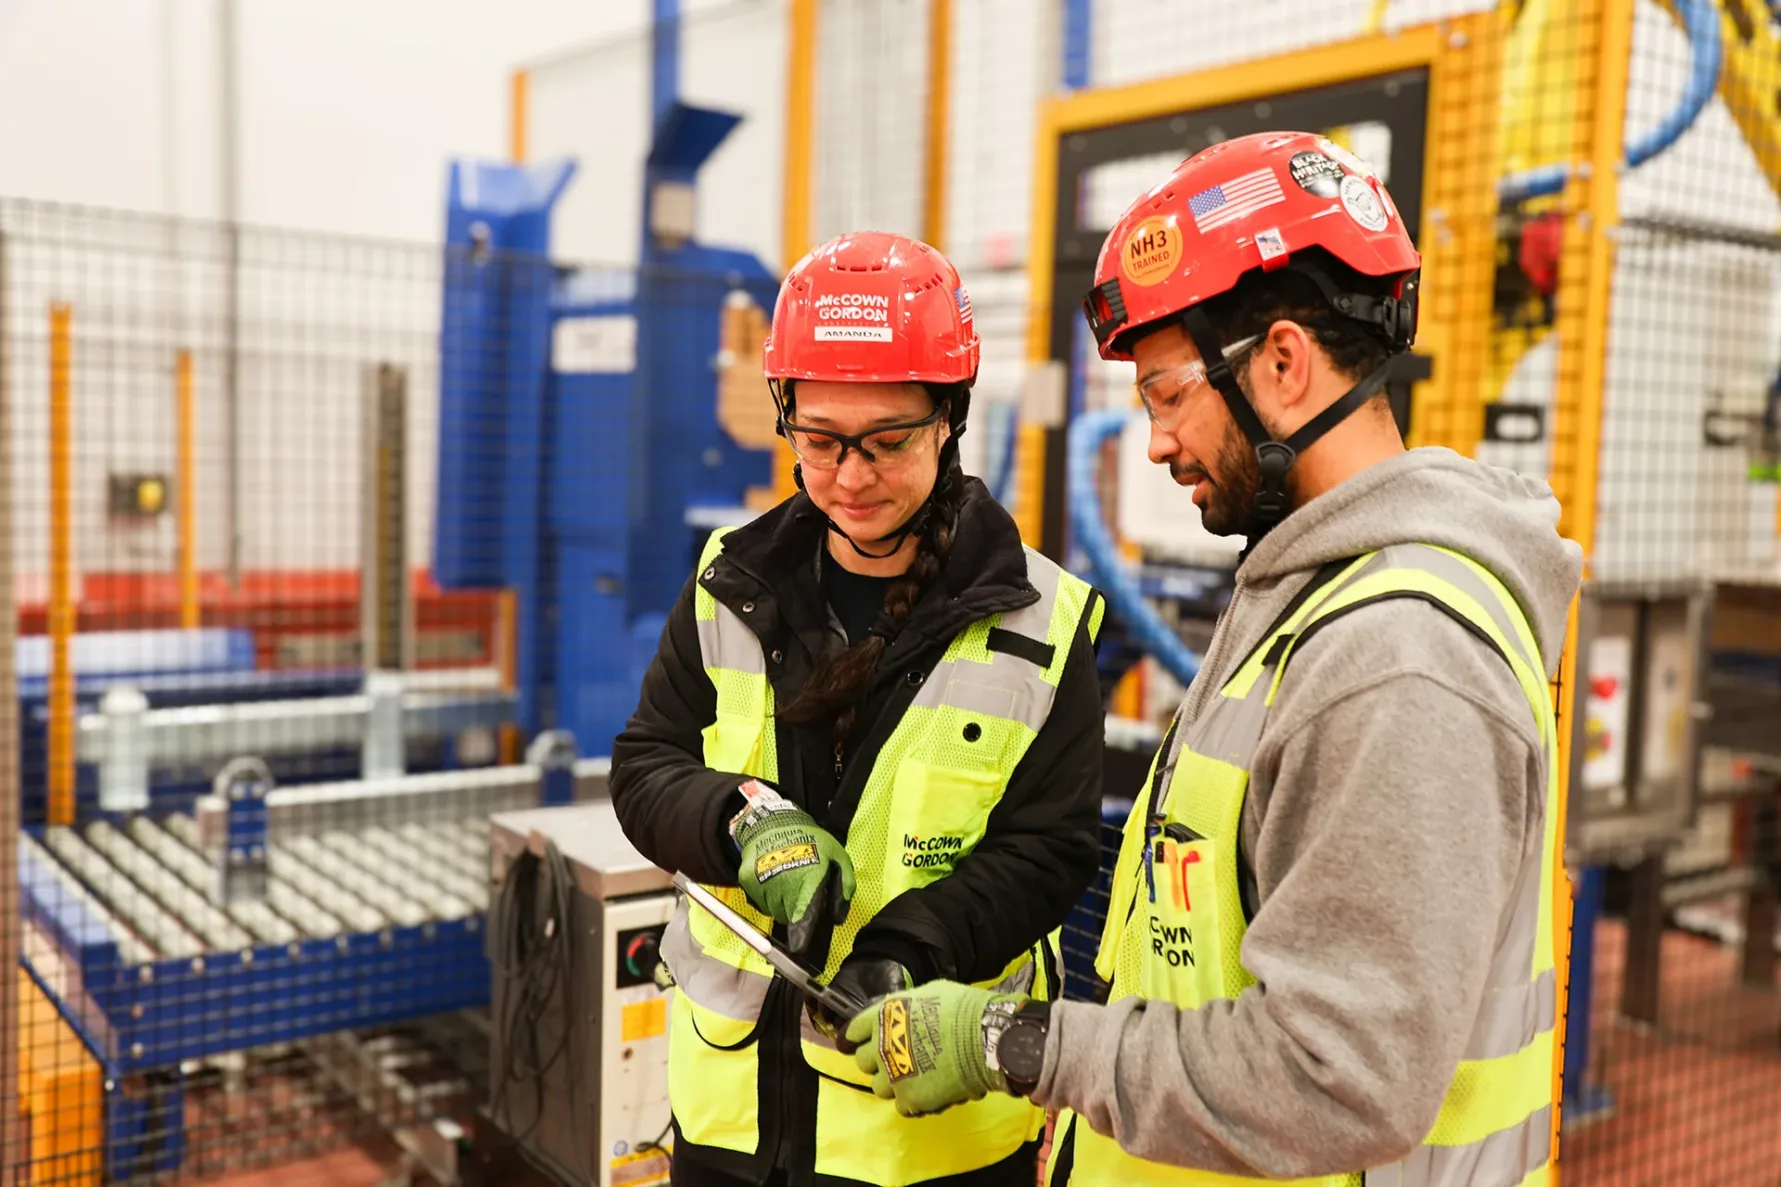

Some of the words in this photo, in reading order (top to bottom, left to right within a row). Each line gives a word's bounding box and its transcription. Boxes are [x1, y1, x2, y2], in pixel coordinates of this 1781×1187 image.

[1131, 230, 1167, 259] NH3
[1132, 250, 1170, 272] TRAINED
[820, 293, 889, 308] McCOWN
[819, 306, 888, 322] GORDON
[824, 330, 882, 338] AMANDA
[903, 833, 965, 851] McCOWN
[901, 851, 959, 869] GORDON
[1149, 915, 1192, 946] CWN
[1152, 937, 1196, 968] RON
